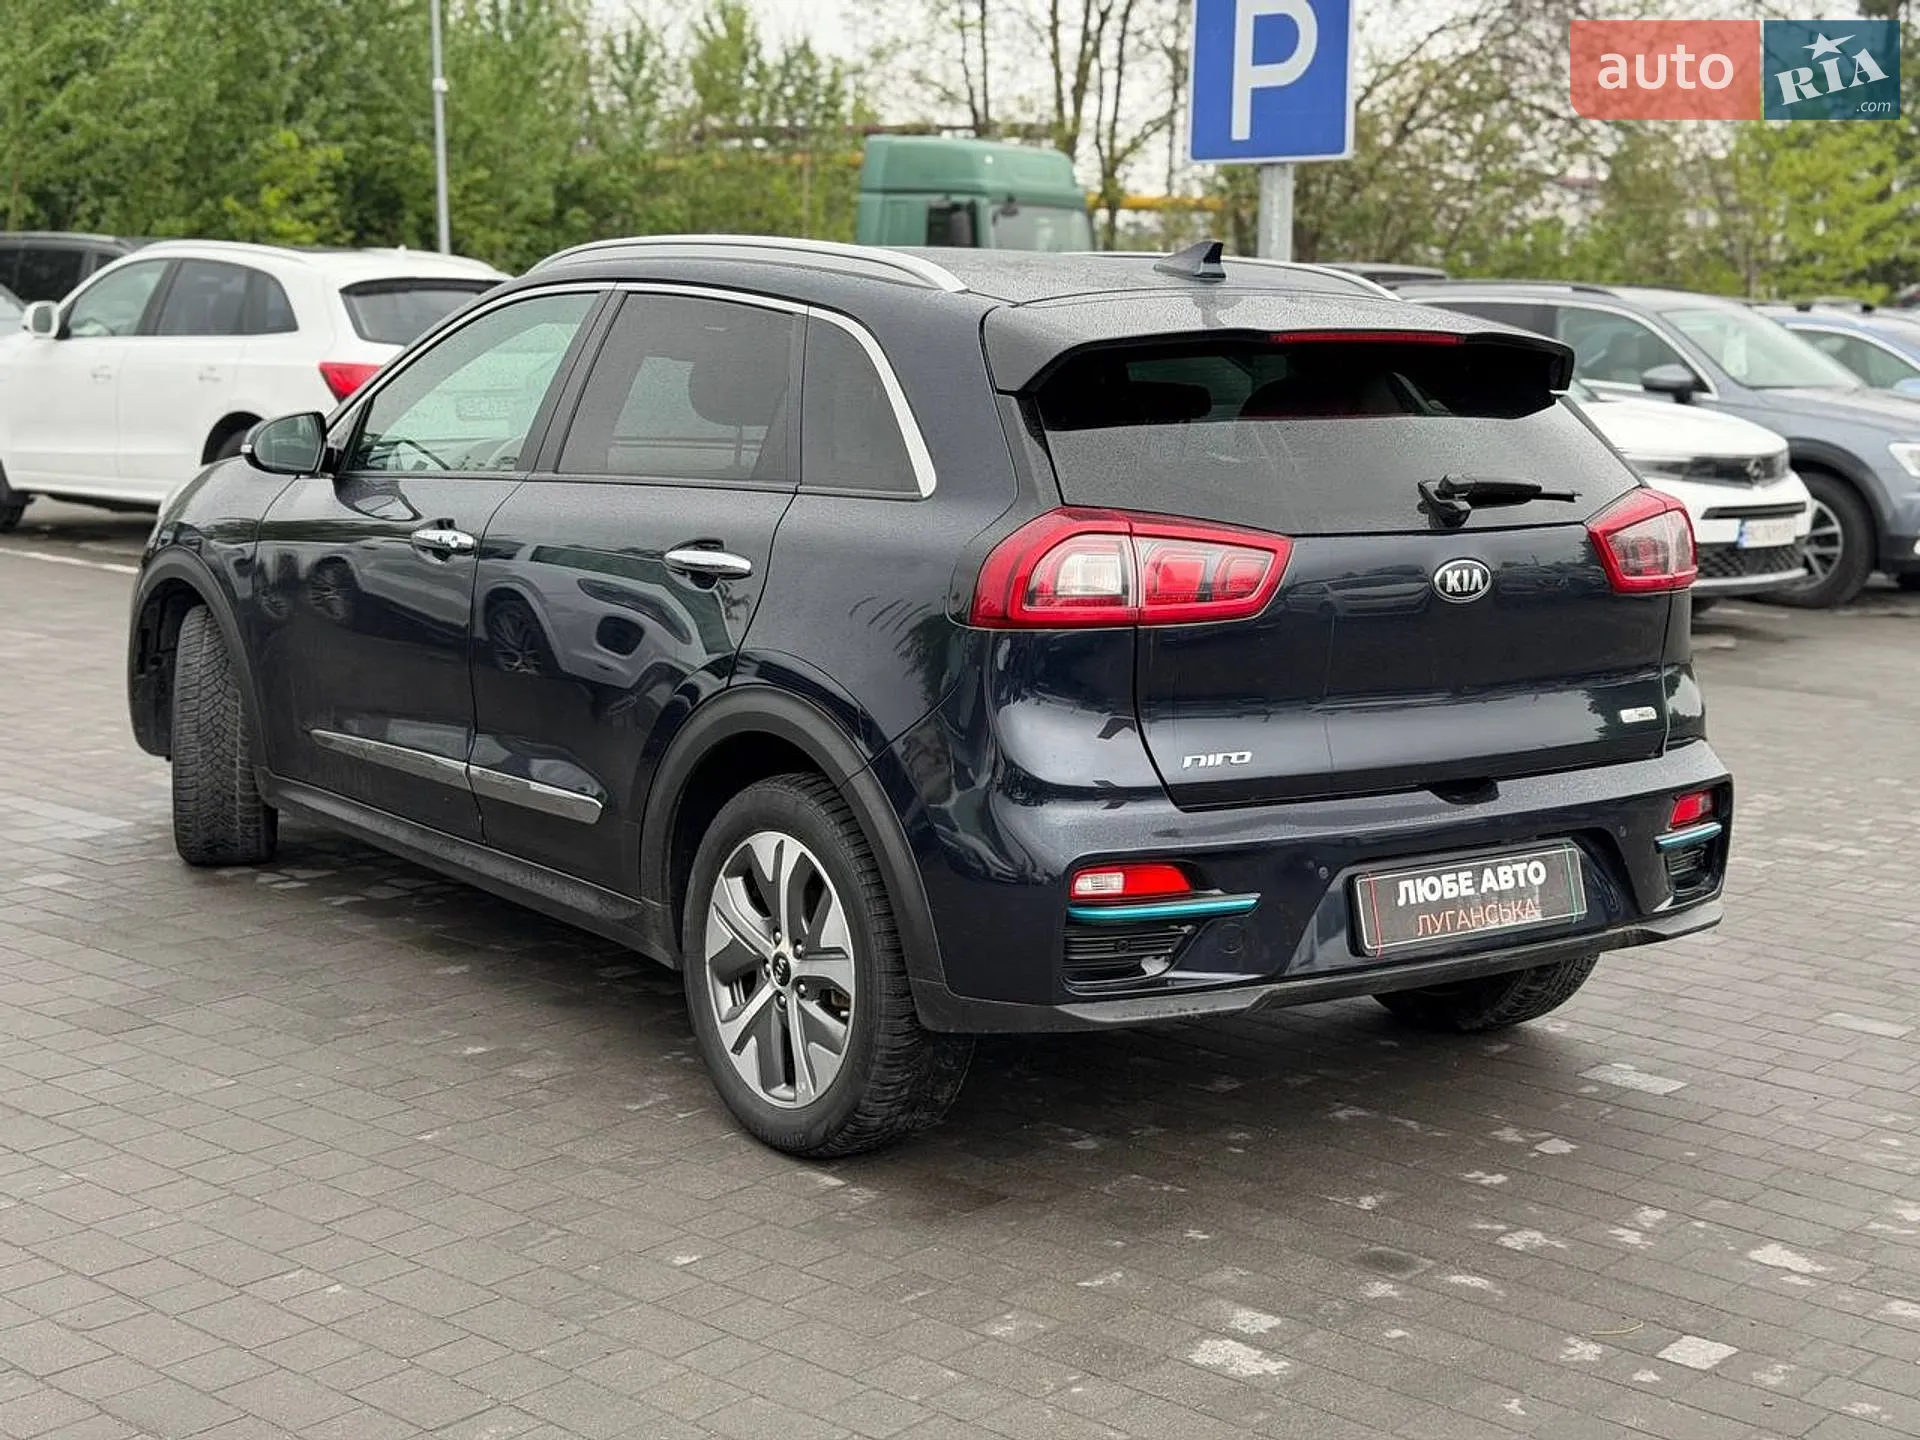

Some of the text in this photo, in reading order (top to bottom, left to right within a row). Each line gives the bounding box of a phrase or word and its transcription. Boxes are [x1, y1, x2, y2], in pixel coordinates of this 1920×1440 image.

[1231, 0, 1318, 141] P
[1445, 568, 1484, 593] KIA
[1396, 860, 1547, 907] ЛЮБЕ АВТО
[1416, 898, 1540, 937] ЛУГАНСЬКА
